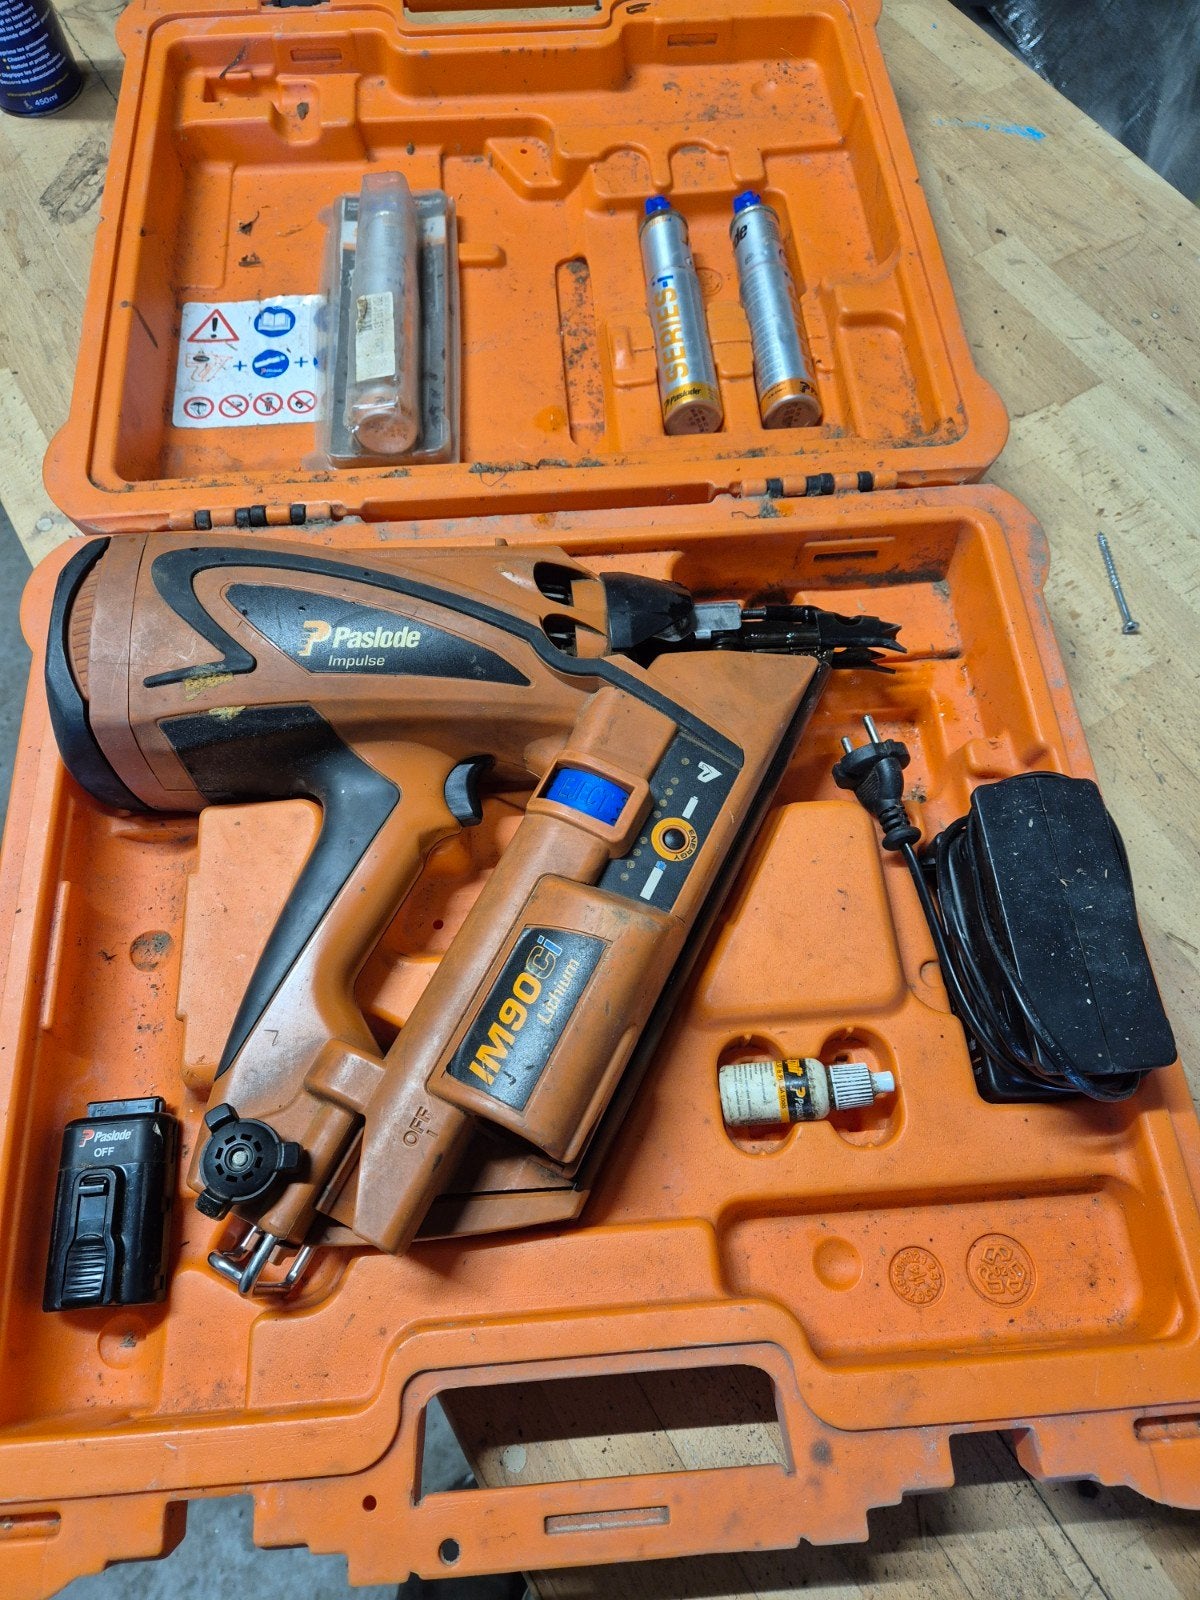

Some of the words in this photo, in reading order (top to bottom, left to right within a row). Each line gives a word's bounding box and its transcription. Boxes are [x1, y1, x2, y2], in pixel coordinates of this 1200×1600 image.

[35, 93, 58, 106] 450ml
[332, 626, 421, 649] Paslode
[328, 654, 385, 669] Impulse
[674, 829, 697, 860] ENERGY
[537, 959, 580, 1025] Lithium
[94, 1129, 131, 1142] Paslode
[403, 1105, 431, 1147] OFF
[94, 1146, 115, 1157] OFF
